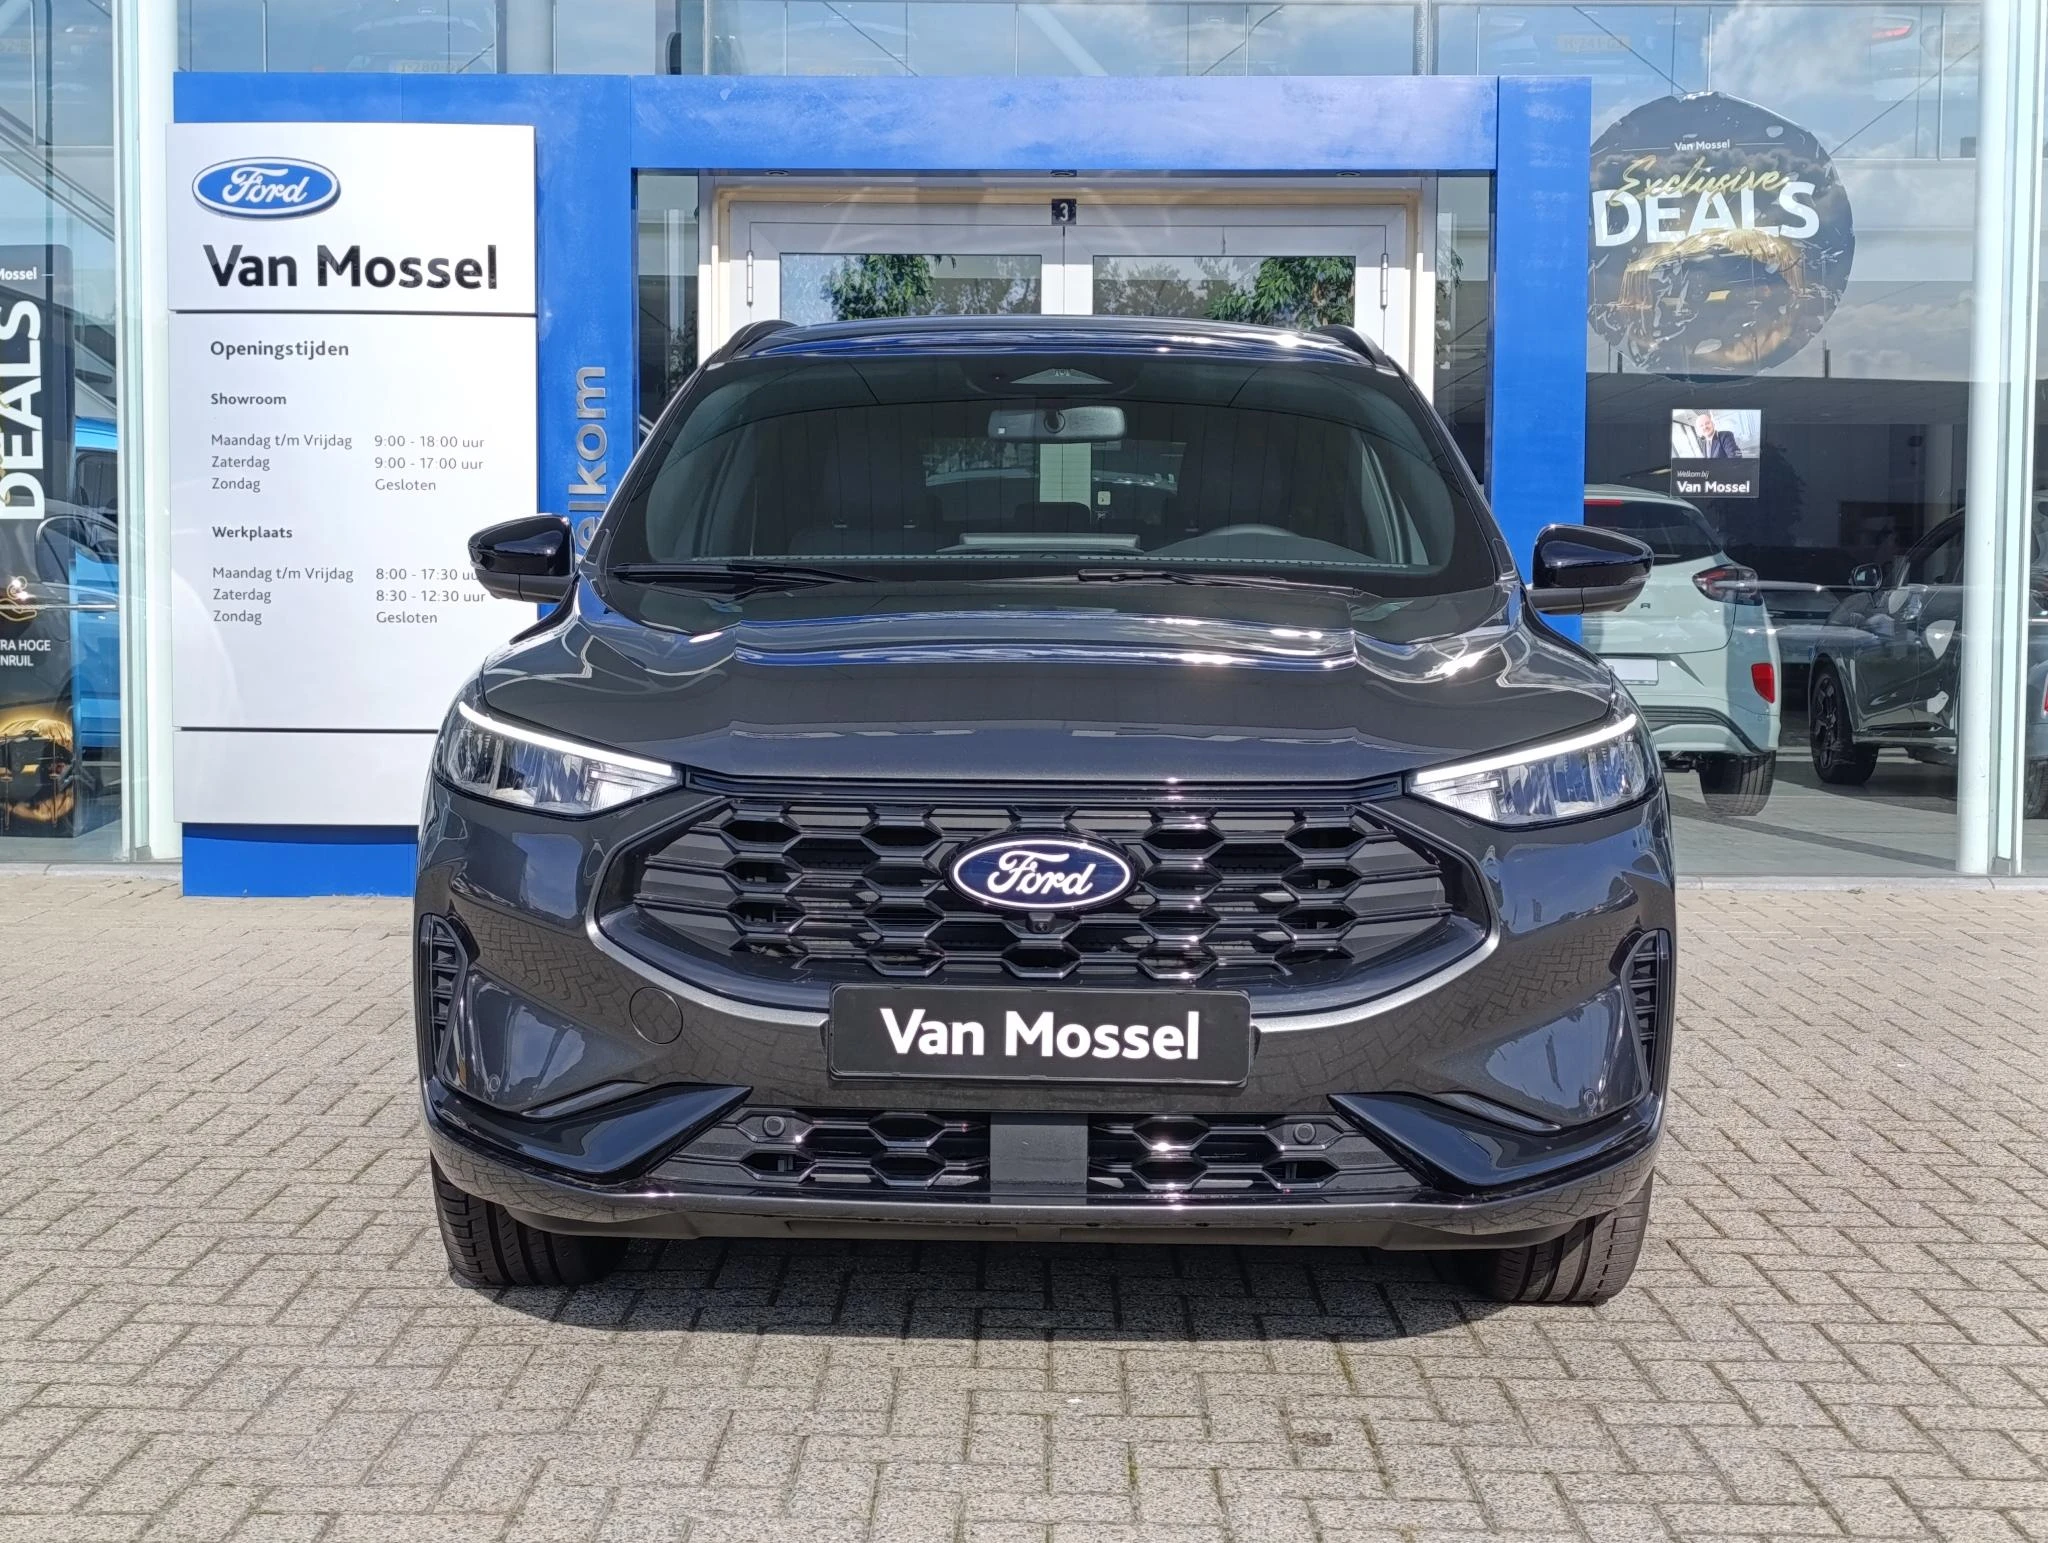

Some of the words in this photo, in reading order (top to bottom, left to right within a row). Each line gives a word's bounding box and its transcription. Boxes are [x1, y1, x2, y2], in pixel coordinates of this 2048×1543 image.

[1674, 141, 1693, 151] Van
[1695, 139, 1730, 150] Mossel
[221, 166, 310, 203] Ford
[1609, 154, 1789, 207] Exclusive
[1060, 202, 1069, 221] 3
[1592, 181, 1820, 247] DEALS
[203, 244, 297, 287] Van
[317, 244, 497, 289] Mossel
[210, 341, 350, 360] Openingstijden
[211, 393, 287, 405] Showroom
[0, 300, 46, 519] DEALS
[211, 434, 271, 449] Maandag
[275, 434, 300, 446] t/m
[304, 434, 353, 450] Vrijdag
[374, 435, 406, 447] 9:00
[420, 435, 458, 448] 18:00
[463, 437, 485, 448] uur
[211, 455, 270, 471] Zaterdag
[374, 457, 406, 469] 9:00
[420, 457, 457, 469] 17:00
[462, 459, 484, 470] uur
[1677, 470, 1700, 478] Welkom
[211, 477, 261, 493] Zondag
[375, 479, 436, 491] Gesloten
[1677, 480, 1701, 493] Van
[1705, 480, 1750, 493] Mossel
[212, 526, 293, 541] Werkplaats
[213, 567, 273, 582] Maandag
[276, 567, 301, 579] t/m
[305, 568, 354, 583] Vrijdag
[376, 568, 407, 580] 8:00
[422, 569, 458, 580] 17:30
[213, 588, 271, 604] Zaterdag
[376, 590, 407, 602] 8:30
[422, 590, 459, 602] 12:30
[464, 592, 485, 602] uur
[213, 610, 262, 626] Zondag
[376, 612, 438, 624] Gesloten
[18, 639, 51, 651] HOGE
[0, 654, 34, 667] NRUIL
[987, 850, 1097, 896] Ford
[880, 1008, 985, 1056] Van
[1005, 1010, 1200, 1060] Mossel
